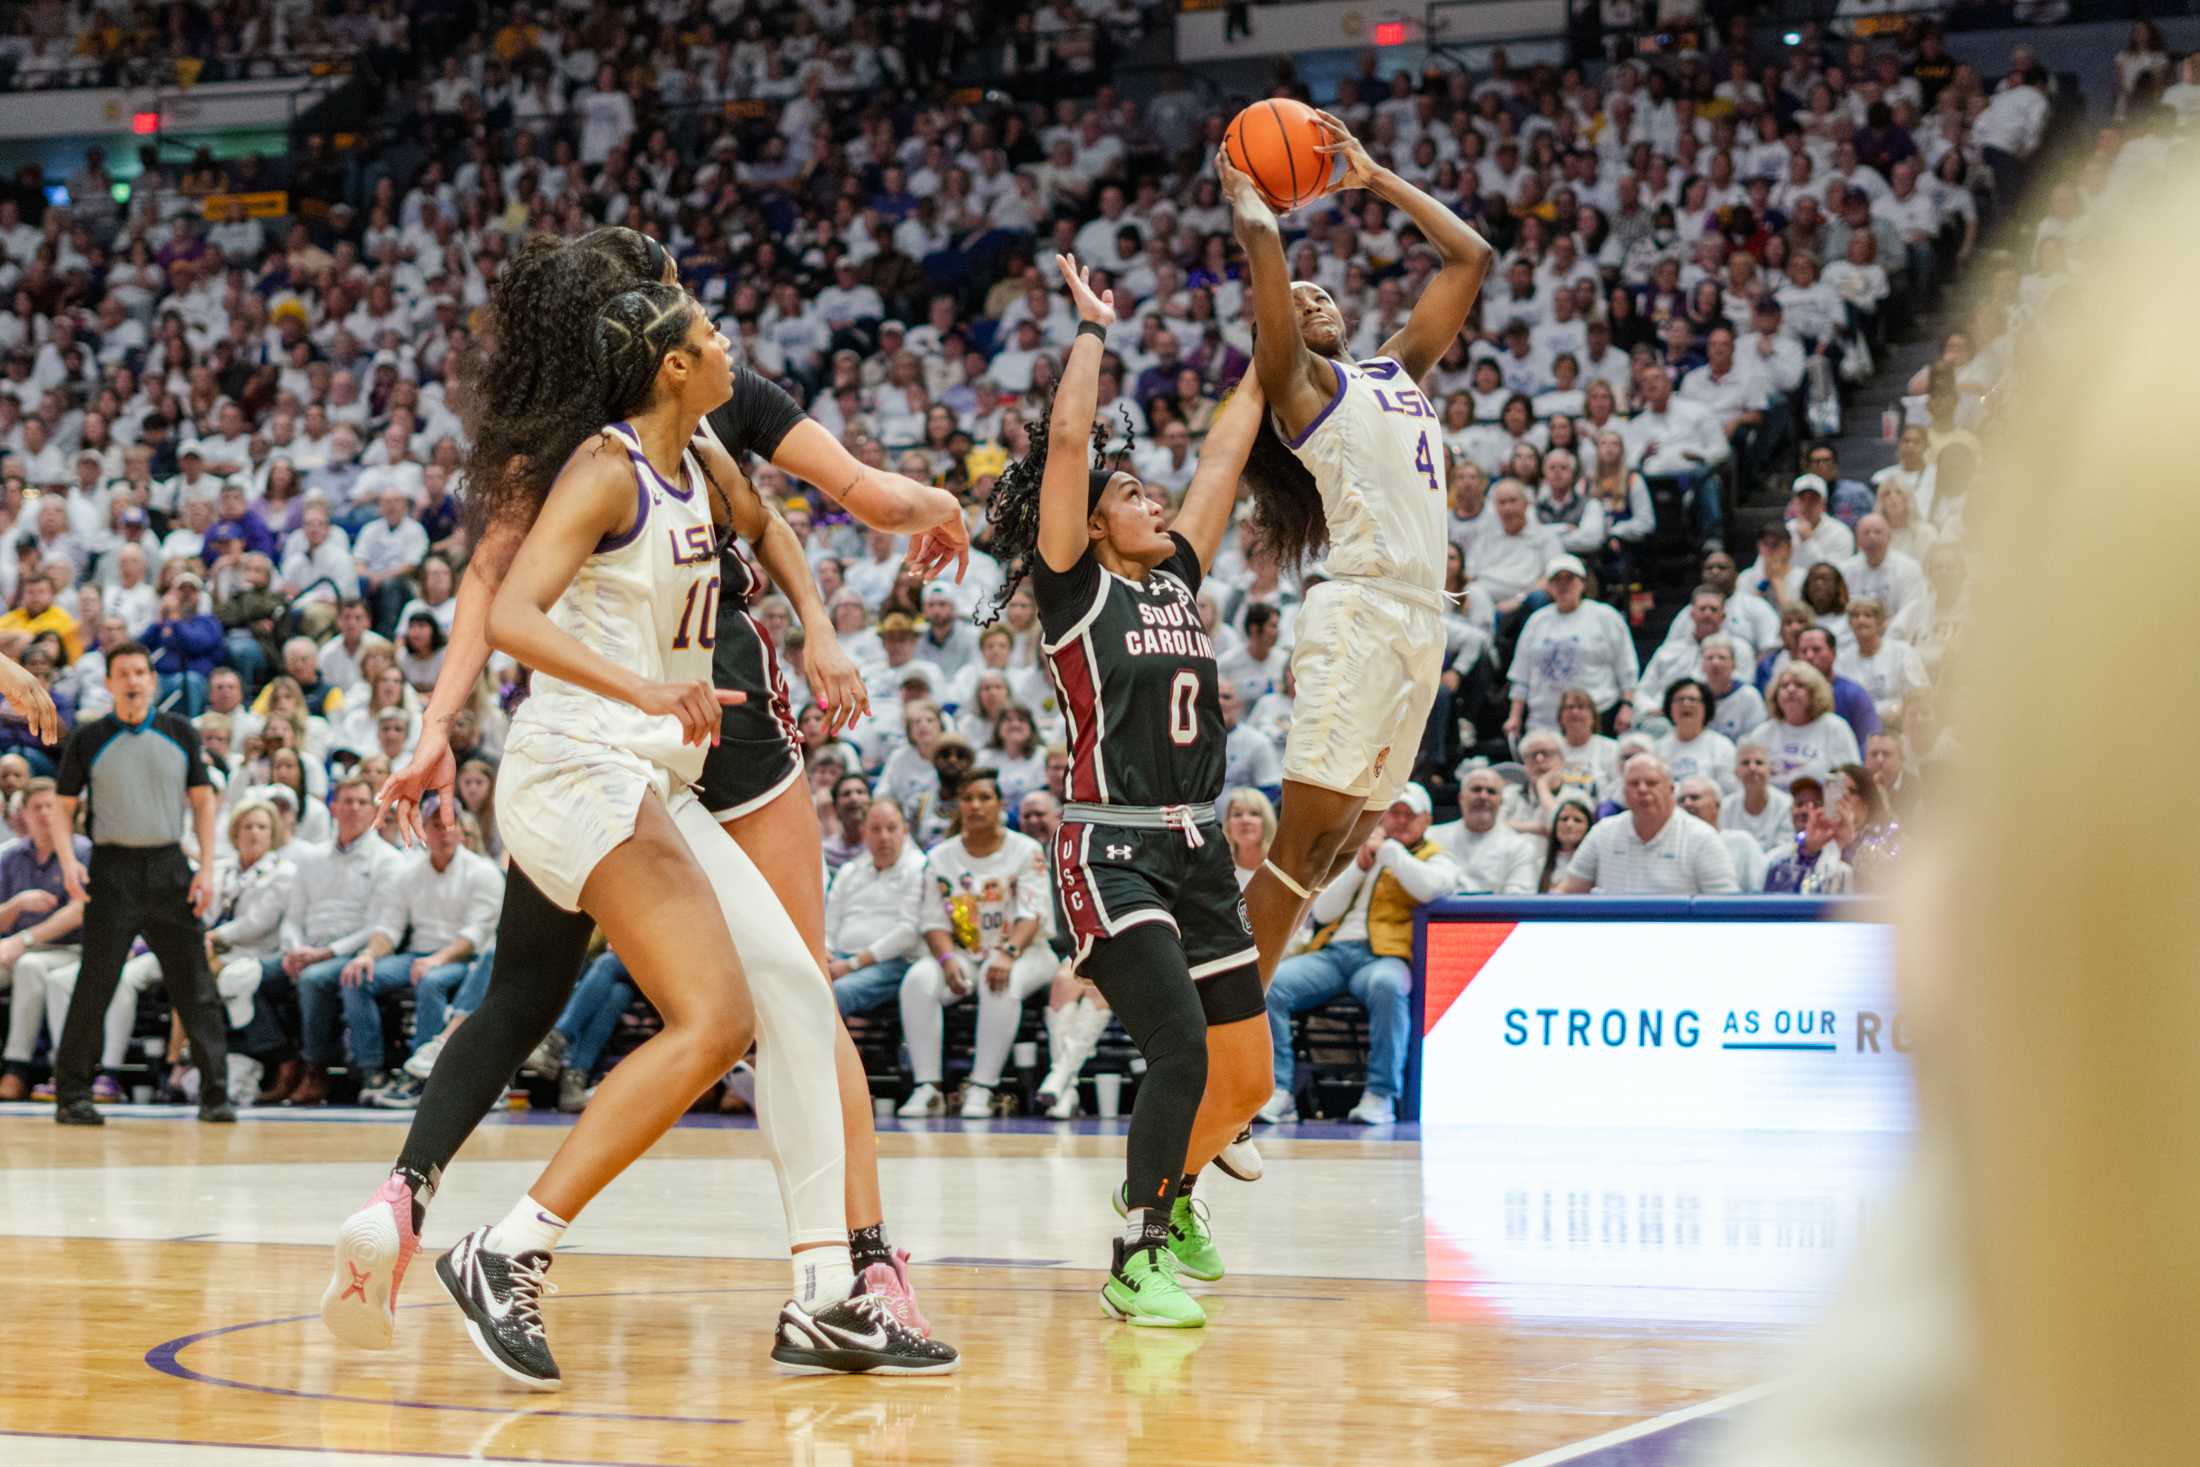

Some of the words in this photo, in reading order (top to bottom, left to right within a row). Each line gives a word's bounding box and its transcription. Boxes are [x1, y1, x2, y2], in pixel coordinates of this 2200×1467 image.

[1414, 429, 1440, 491] 4
[671, 576, 720, 650] 10
[1168, 668, 1201, 746] 0
[1063, 839, 1083, 911] USC
[1503, 1007, 1700, 1049] STRONG
[1723, 1009, 1760, 1035] AS
[1774, 1009, 1836, 1036] OUR
